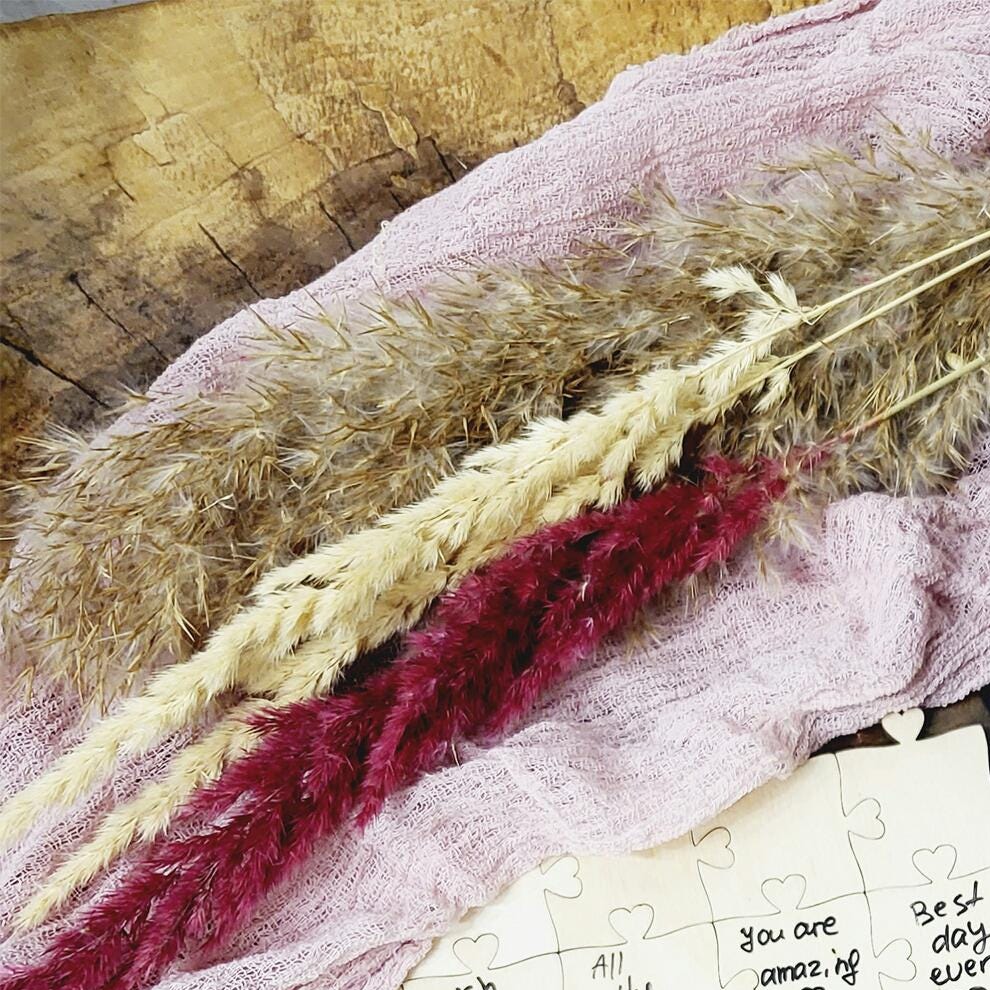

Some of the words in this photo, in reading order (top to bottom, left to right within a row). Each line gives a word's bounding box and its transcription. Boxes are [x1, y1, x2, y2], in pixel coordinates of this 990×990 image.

[910, 880, 983, 926] Best
[793, 915, 839, 939] are
[592, 951, 623, 980] All
